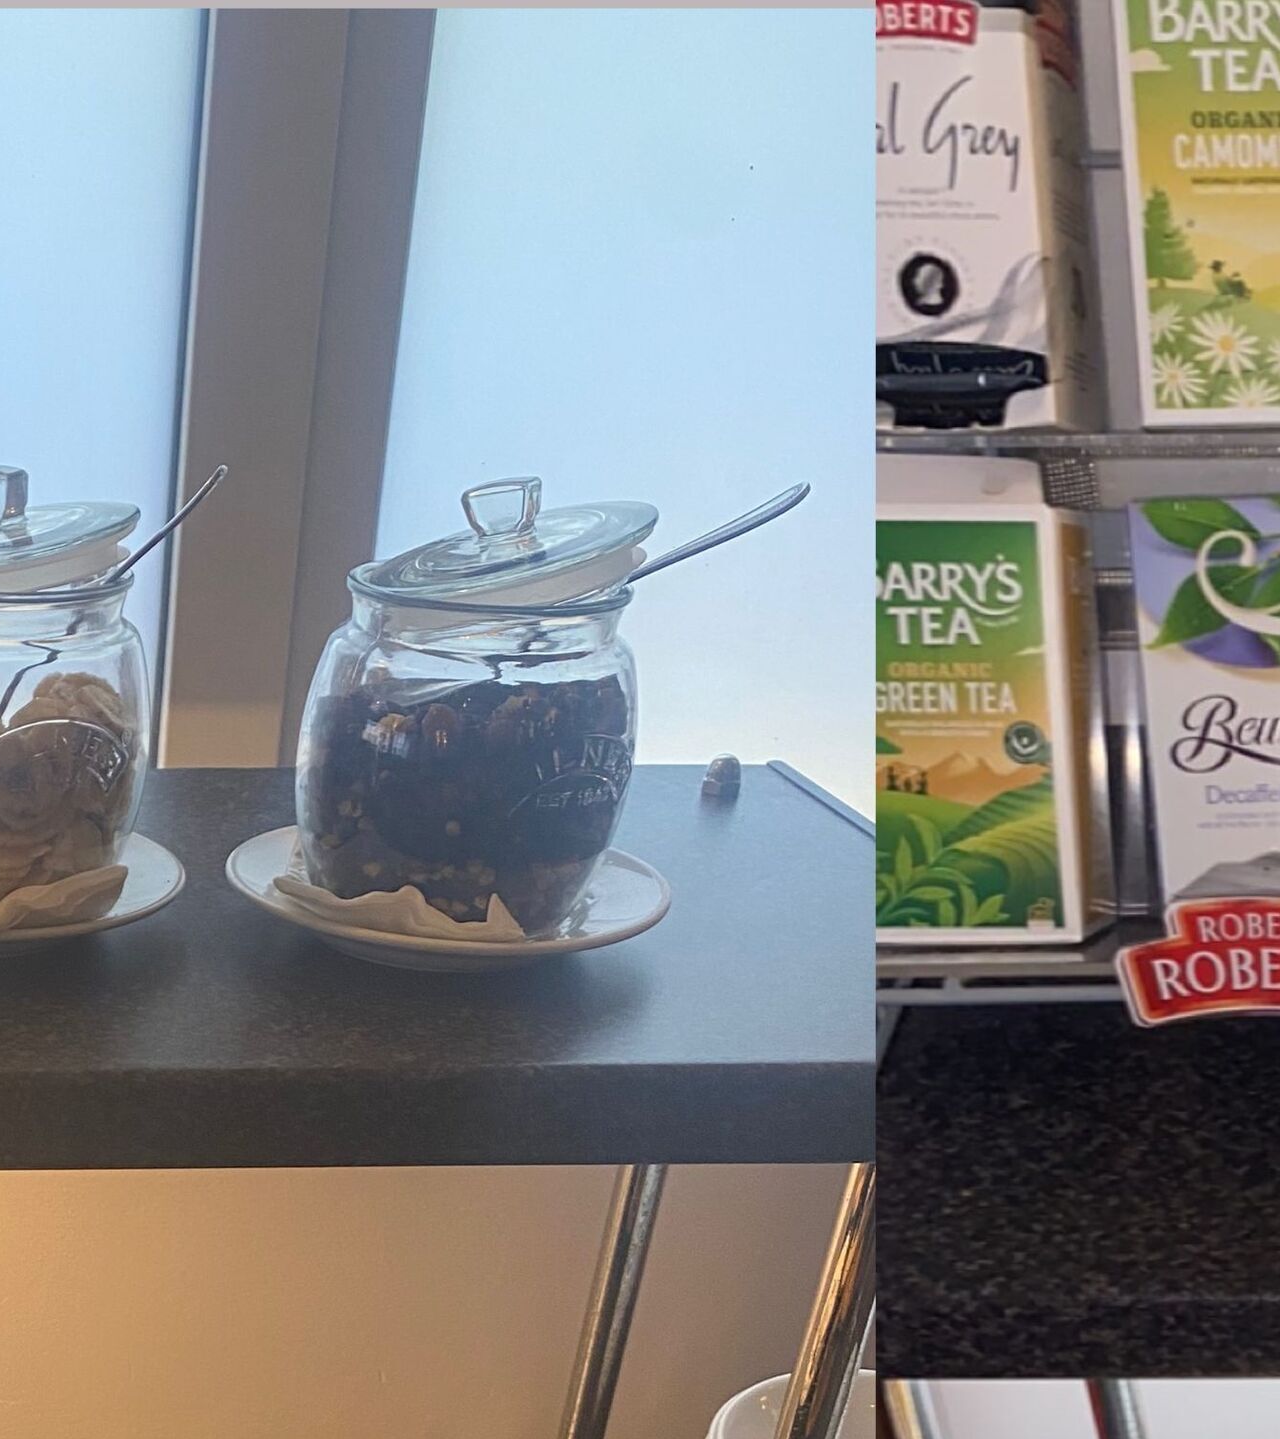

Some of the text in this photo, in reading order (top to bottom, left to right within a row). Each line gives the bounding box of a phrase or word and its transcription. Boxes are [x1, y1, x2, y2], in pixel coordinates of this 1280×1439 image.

[922, 74, 1020, 193] Grey
[886, 606, 983, 646] TEA
[888, 660, 994, 680] ORGANIC
[876, 680, 1019, 716] GREEN TEA
